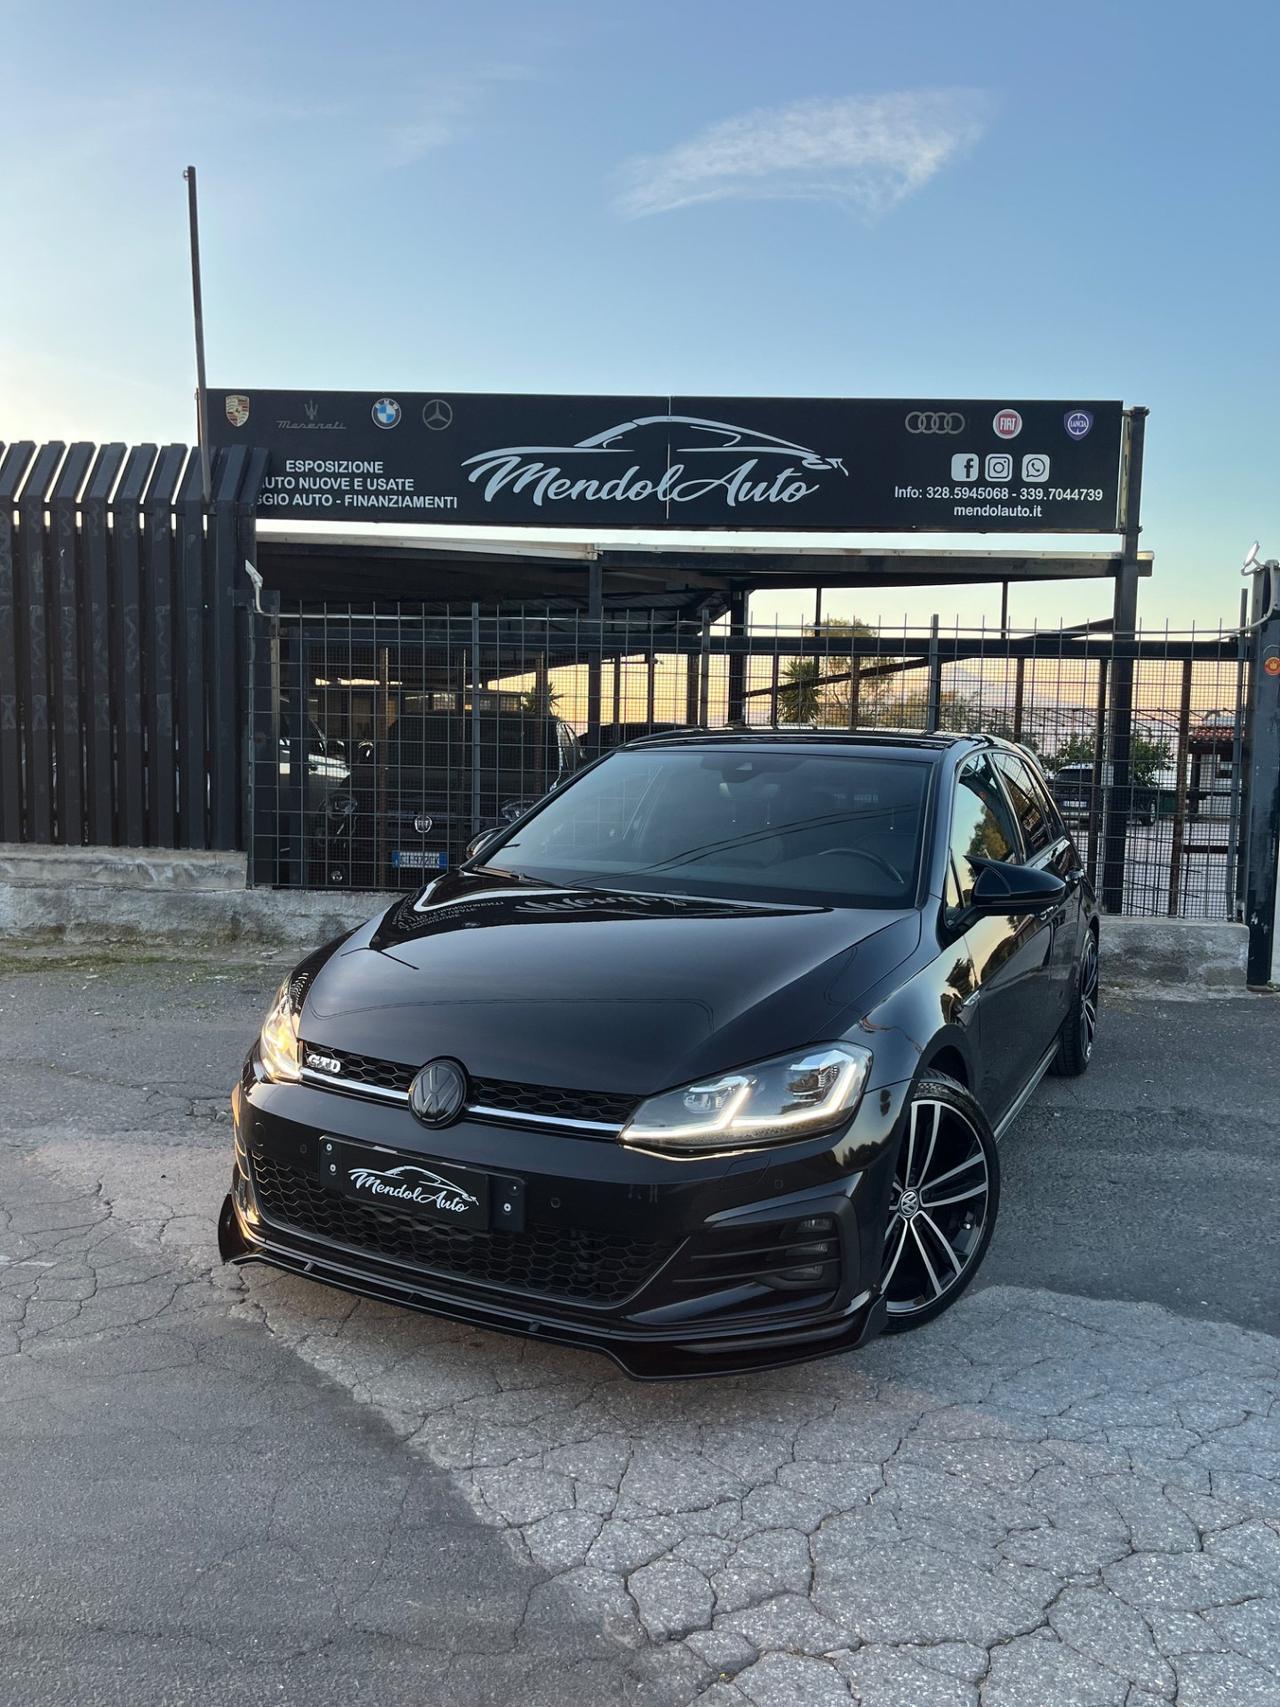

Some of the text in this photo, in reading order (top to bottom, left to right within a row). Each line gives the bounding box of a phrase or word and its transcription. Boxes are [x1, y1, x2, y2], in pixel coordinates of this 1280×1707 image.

[276, 420, 347, 430] Maserati
[999, 417, 1017, 431] FIAT
[1070, 419, 1087, 428] LANCIA
[285, 459, 384, 474] ESPOSIZIONE
[261, 476, 415, 491] UTO NUOVE E USATE
[292, 493, 333, 507] AUTO
[344, 494, 458, 509] FINANZIAMENTI
[894, 486, 923, 498] Info:
[926, 487, 1009, 499] 328.5945068
[1019, 488, 1104, 501] 339.7044739
[953, 504, 1043, 518] mendolauto.it
[307, 1054, 342, 1074] GTD
